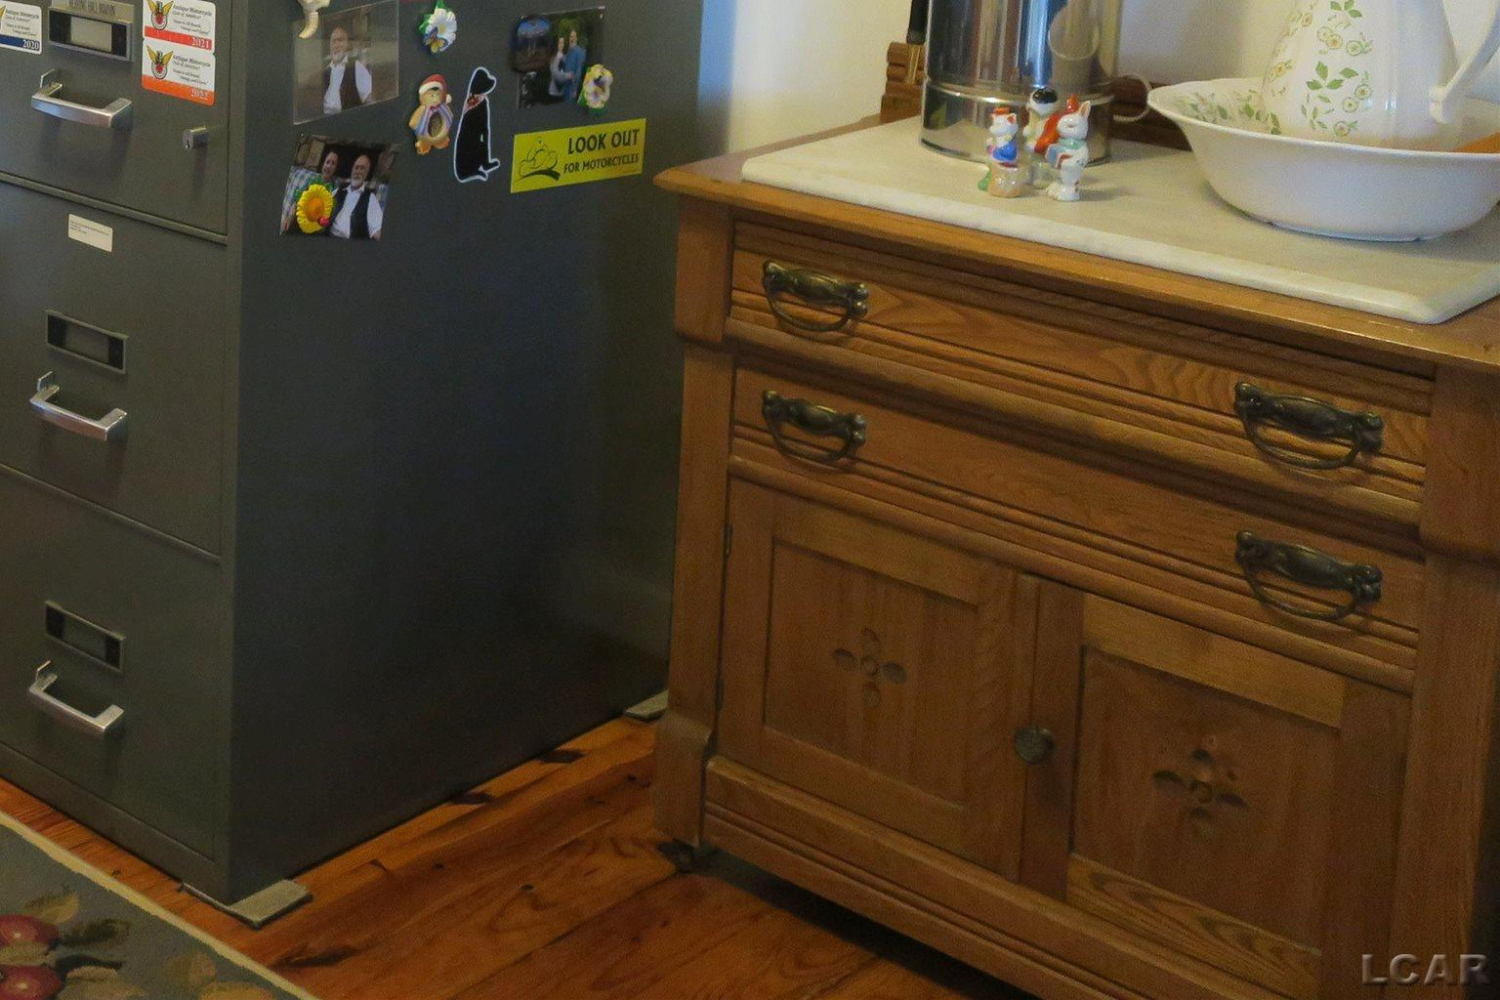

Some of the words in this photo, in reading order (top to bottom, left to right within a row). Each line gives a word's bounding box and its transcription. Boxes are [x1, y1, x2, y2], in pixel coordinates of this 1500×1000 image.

[568, 133, 607, 155] LOOK
[611, 129, 640, 148] OUT
[564, 162, 580, 174] FOR
[582, 153, 639, 171] MOTORCYCLES
